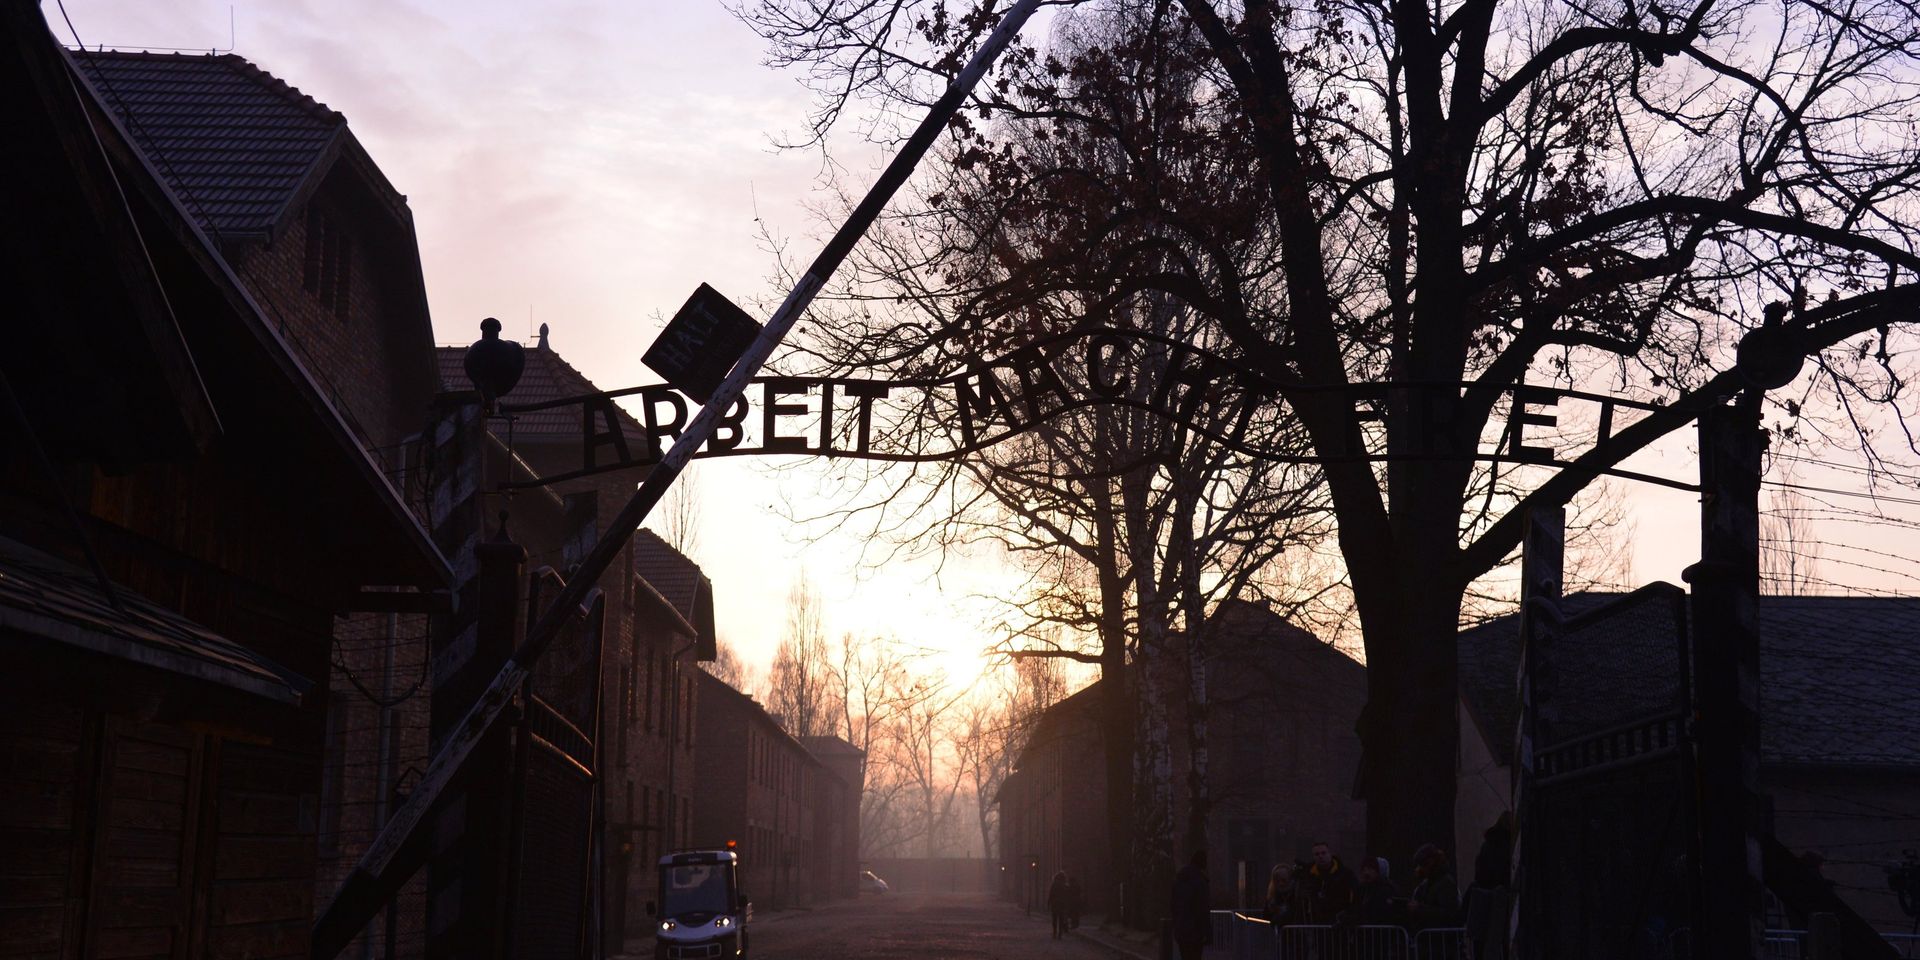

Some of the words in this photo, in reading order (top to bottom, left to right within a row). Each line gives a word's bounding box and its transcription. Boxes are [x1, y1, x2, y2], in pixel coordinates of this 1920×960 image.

[658, 300, 719, 371] HALT
[583, 381, 889, 469] ARBEIT
[954, 335, 1268, 447] MACHT
